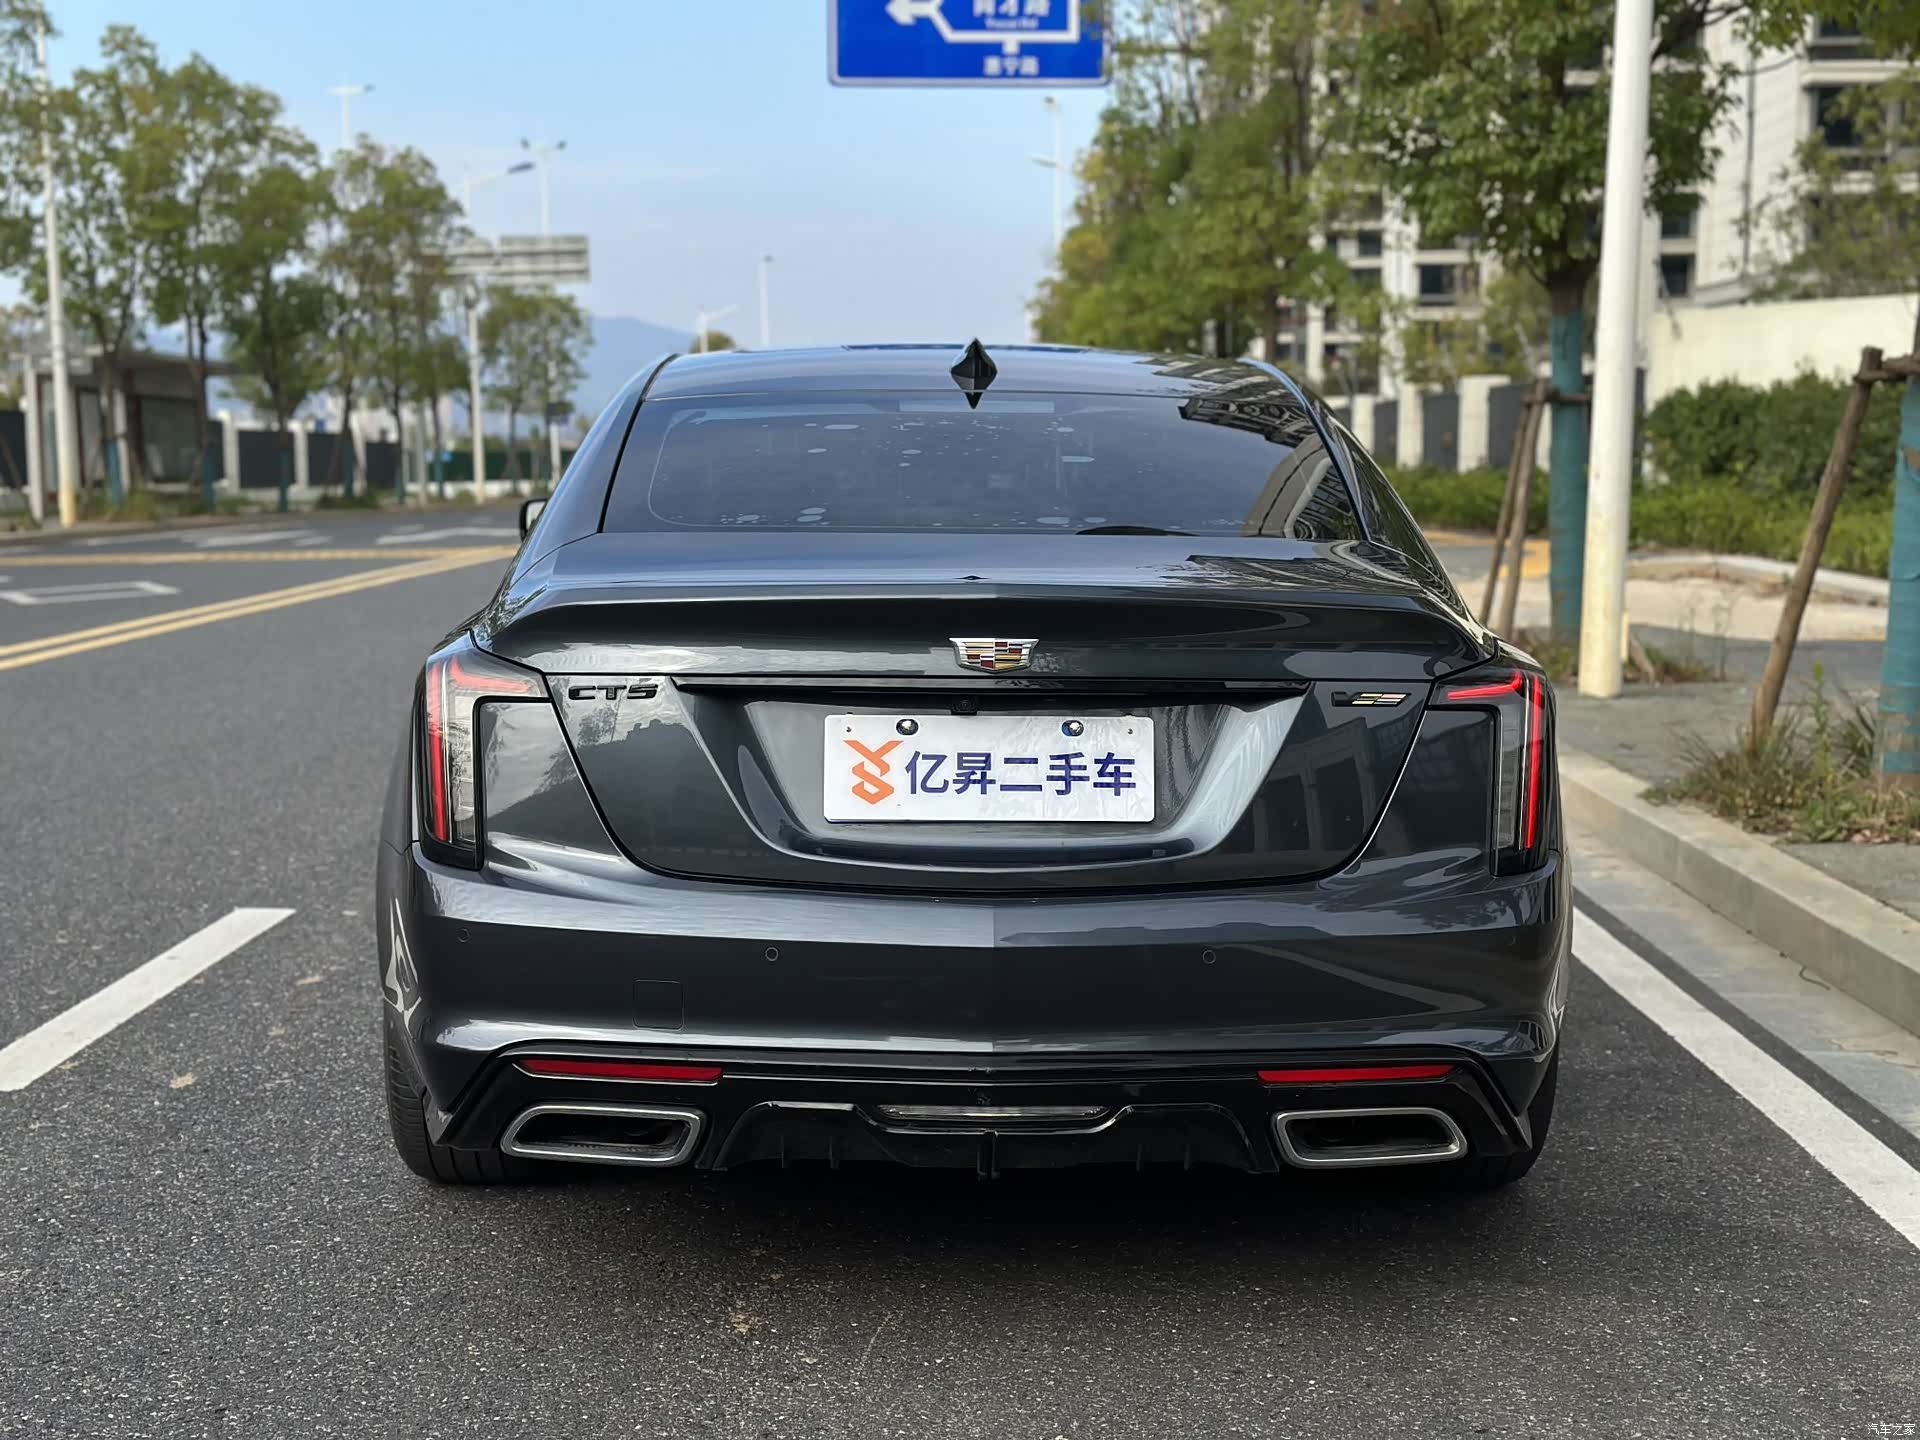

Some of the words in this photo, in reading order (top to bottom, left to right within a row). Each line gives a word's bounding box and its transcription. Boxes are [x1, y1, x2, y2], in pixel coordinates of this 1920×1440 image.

[905, 751, 1137, 797] 亿昇二手车
